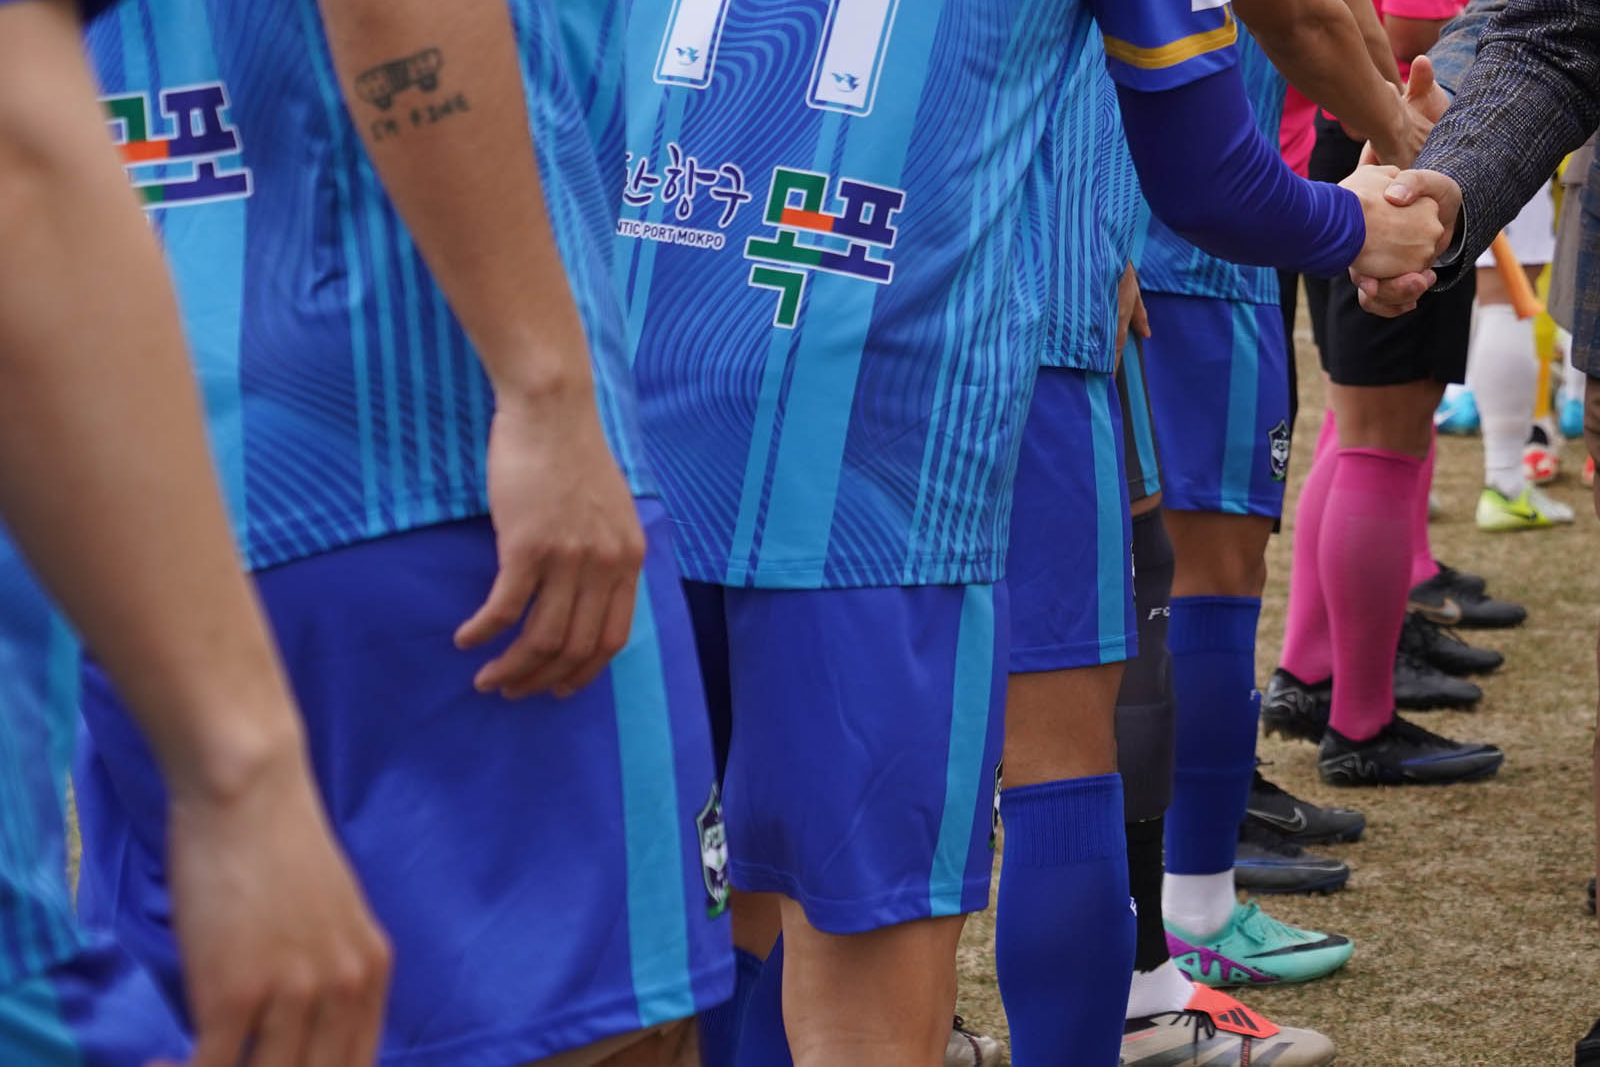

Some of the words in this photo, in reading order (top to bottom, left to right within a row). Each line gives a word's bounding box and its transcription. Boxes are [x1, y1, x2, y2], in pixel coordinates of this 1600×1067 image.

[643, 224, 674, 240] PORT
[676, 230, 724, 250] MOKPO
[743, 166, 906, 330] 목포
